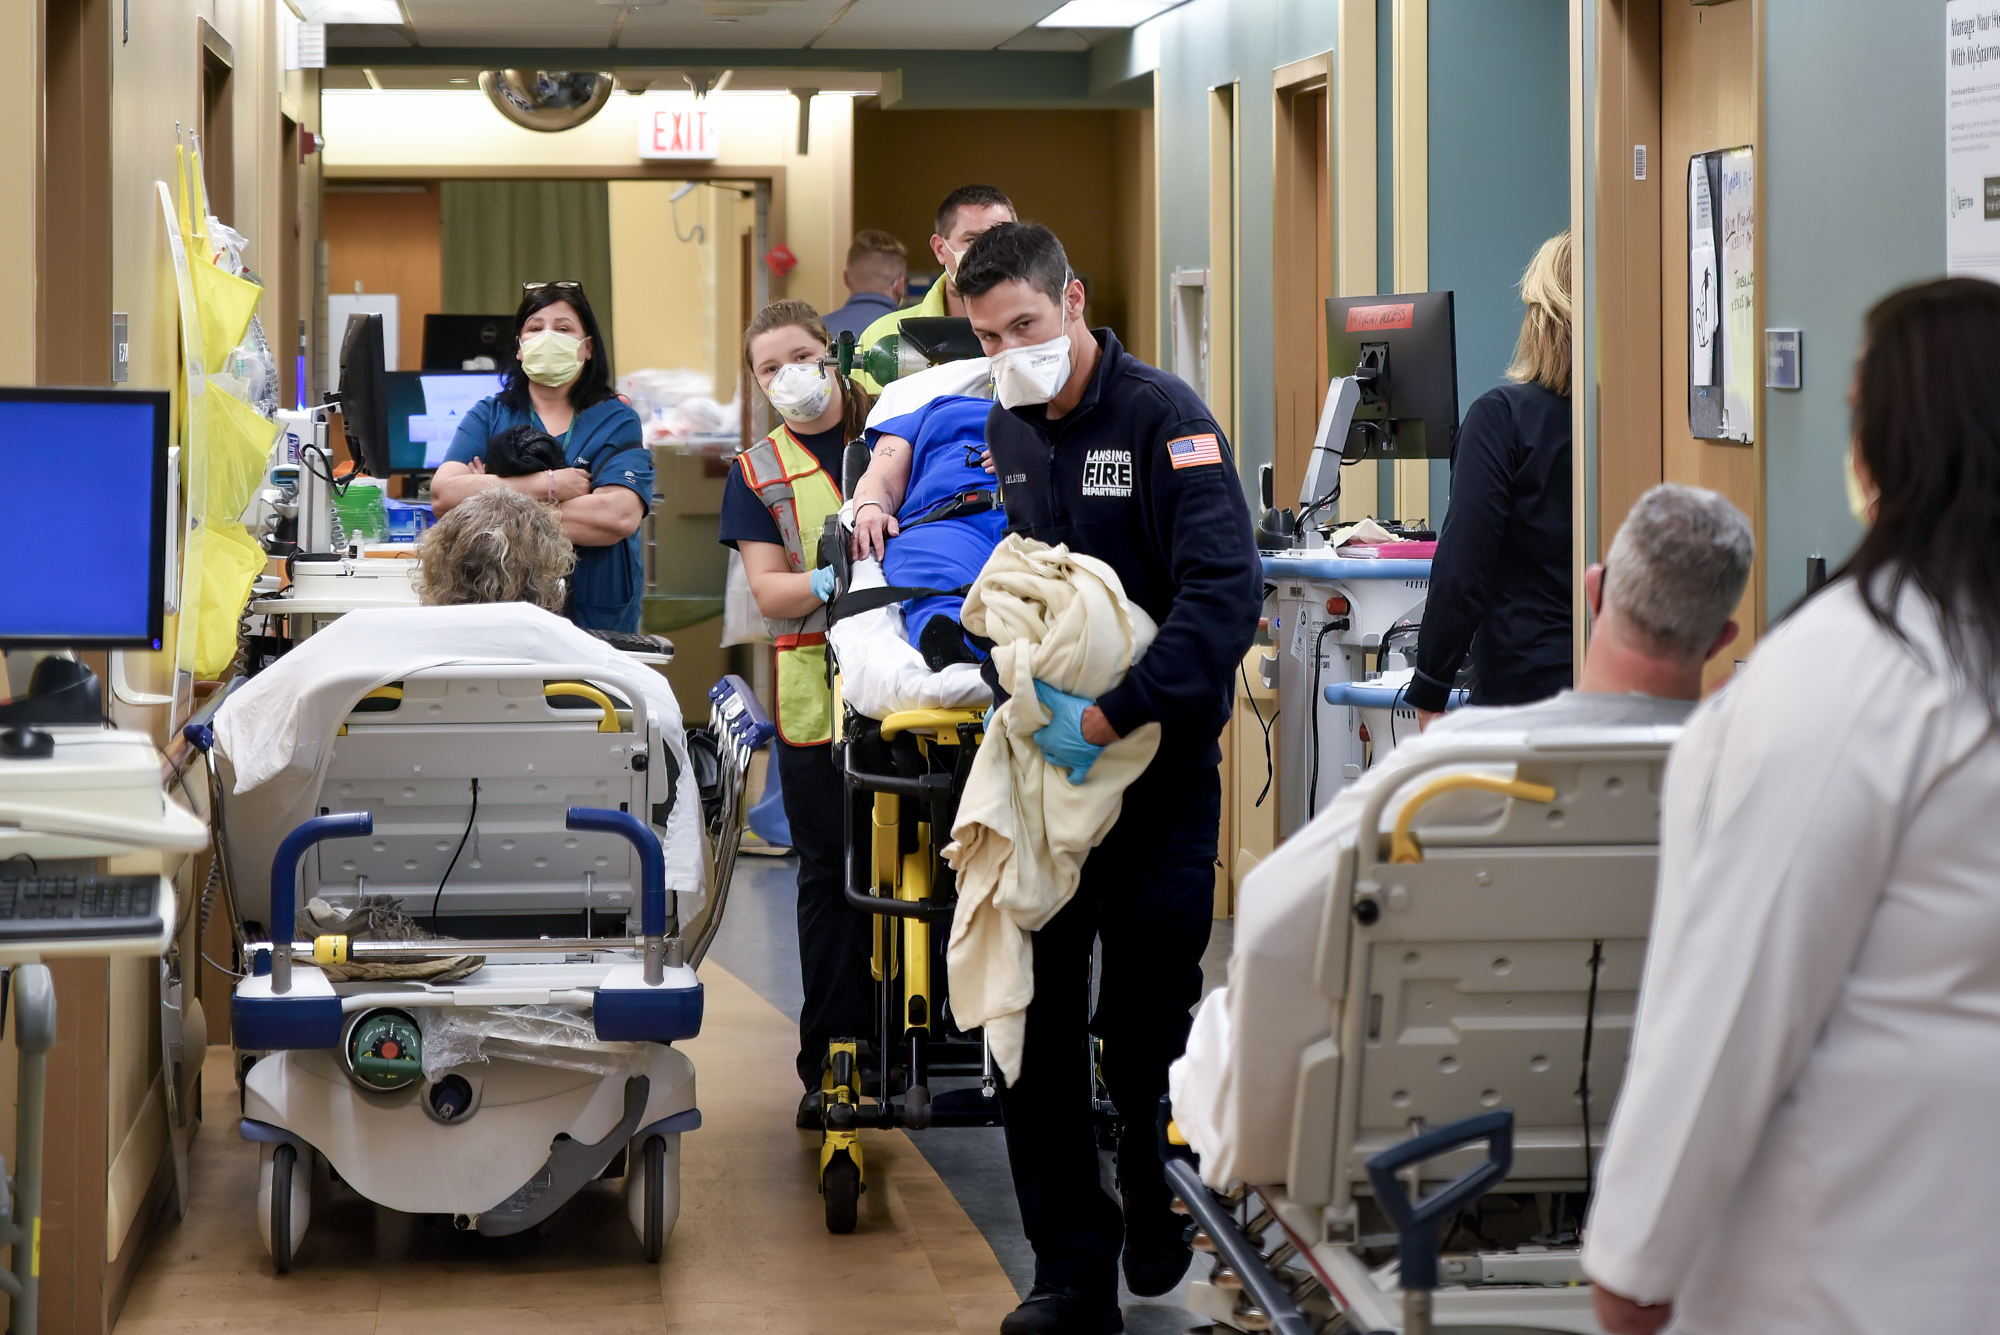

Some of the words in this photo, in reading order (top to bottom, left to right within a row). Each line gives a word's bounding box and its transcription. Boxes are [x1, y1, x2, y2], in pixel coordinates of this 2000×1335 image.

[653, 111, 707, 152] EXIT
[1086, 449, 1132, 463] LANSING
[1082, 461, 1133, 488] FIRE
[1082, 486, 1133, 498] DEPARTMENT
